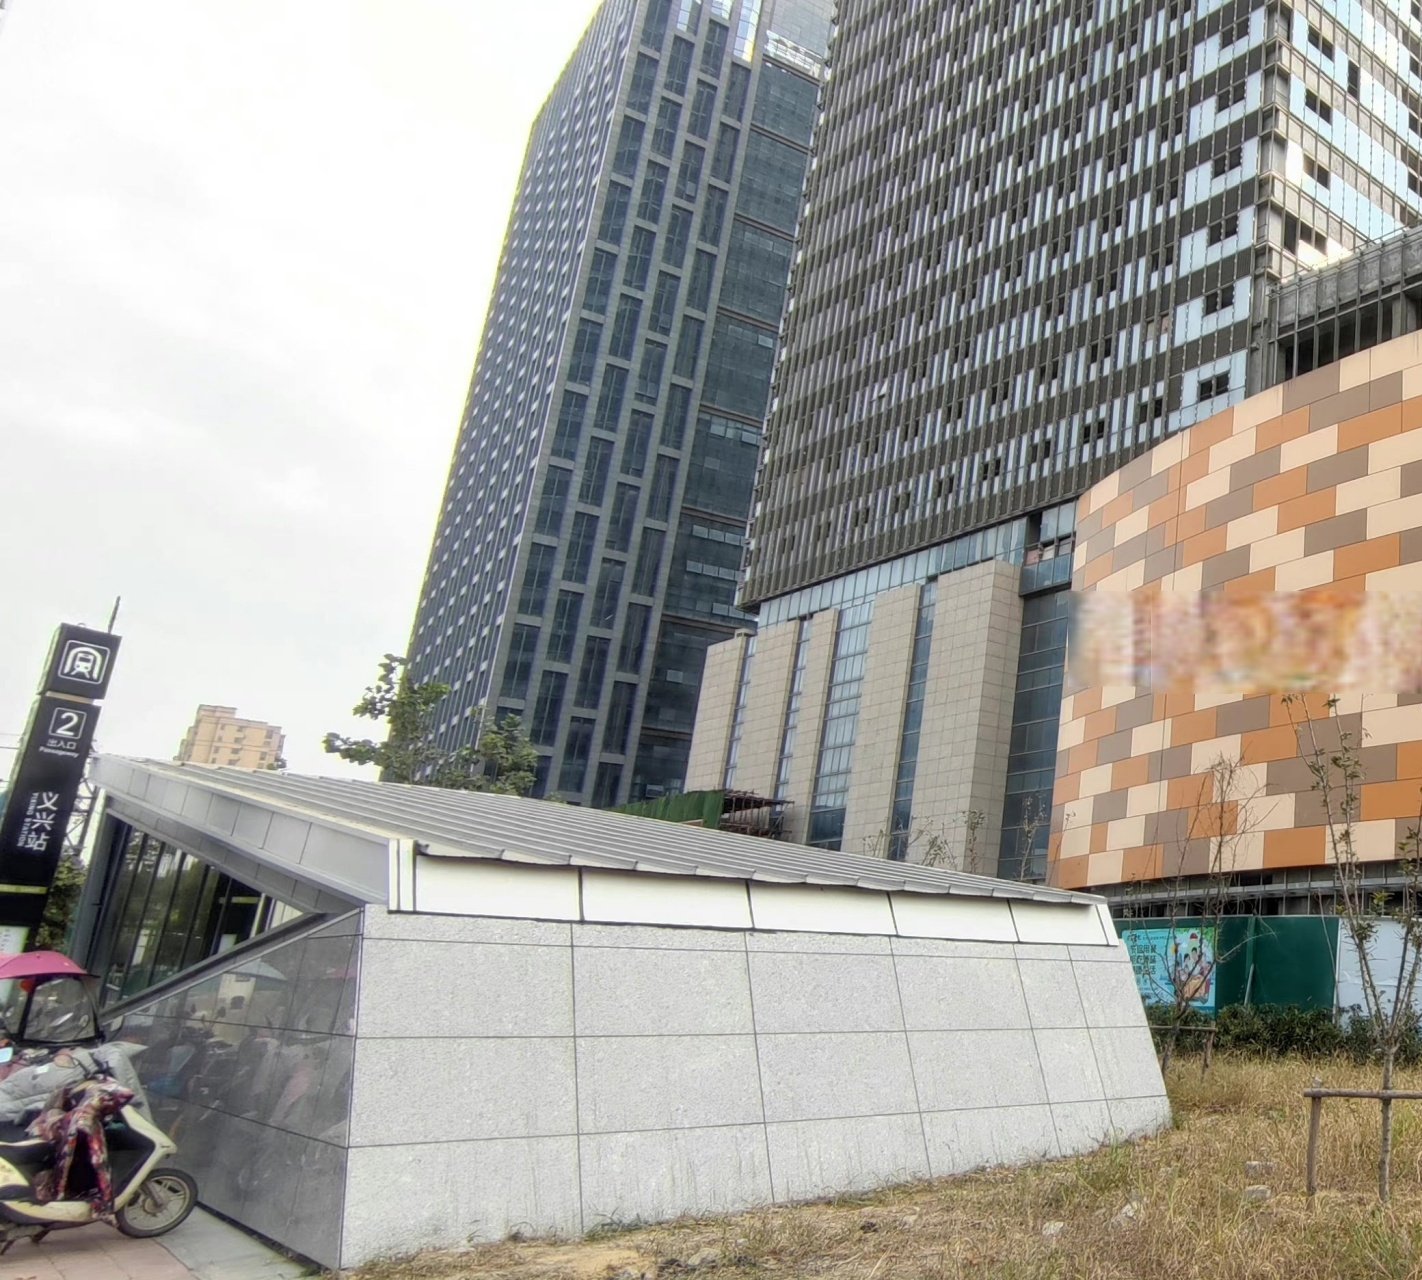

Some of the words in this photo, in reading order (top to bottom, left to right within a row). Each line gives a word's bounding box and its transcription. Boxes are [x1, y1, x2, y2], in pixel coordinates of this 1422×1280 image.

[56, 712, 79, 736] 2
[46, 738, 77, 750] 出入口
[24, 791, 59, 851] 义兴站
